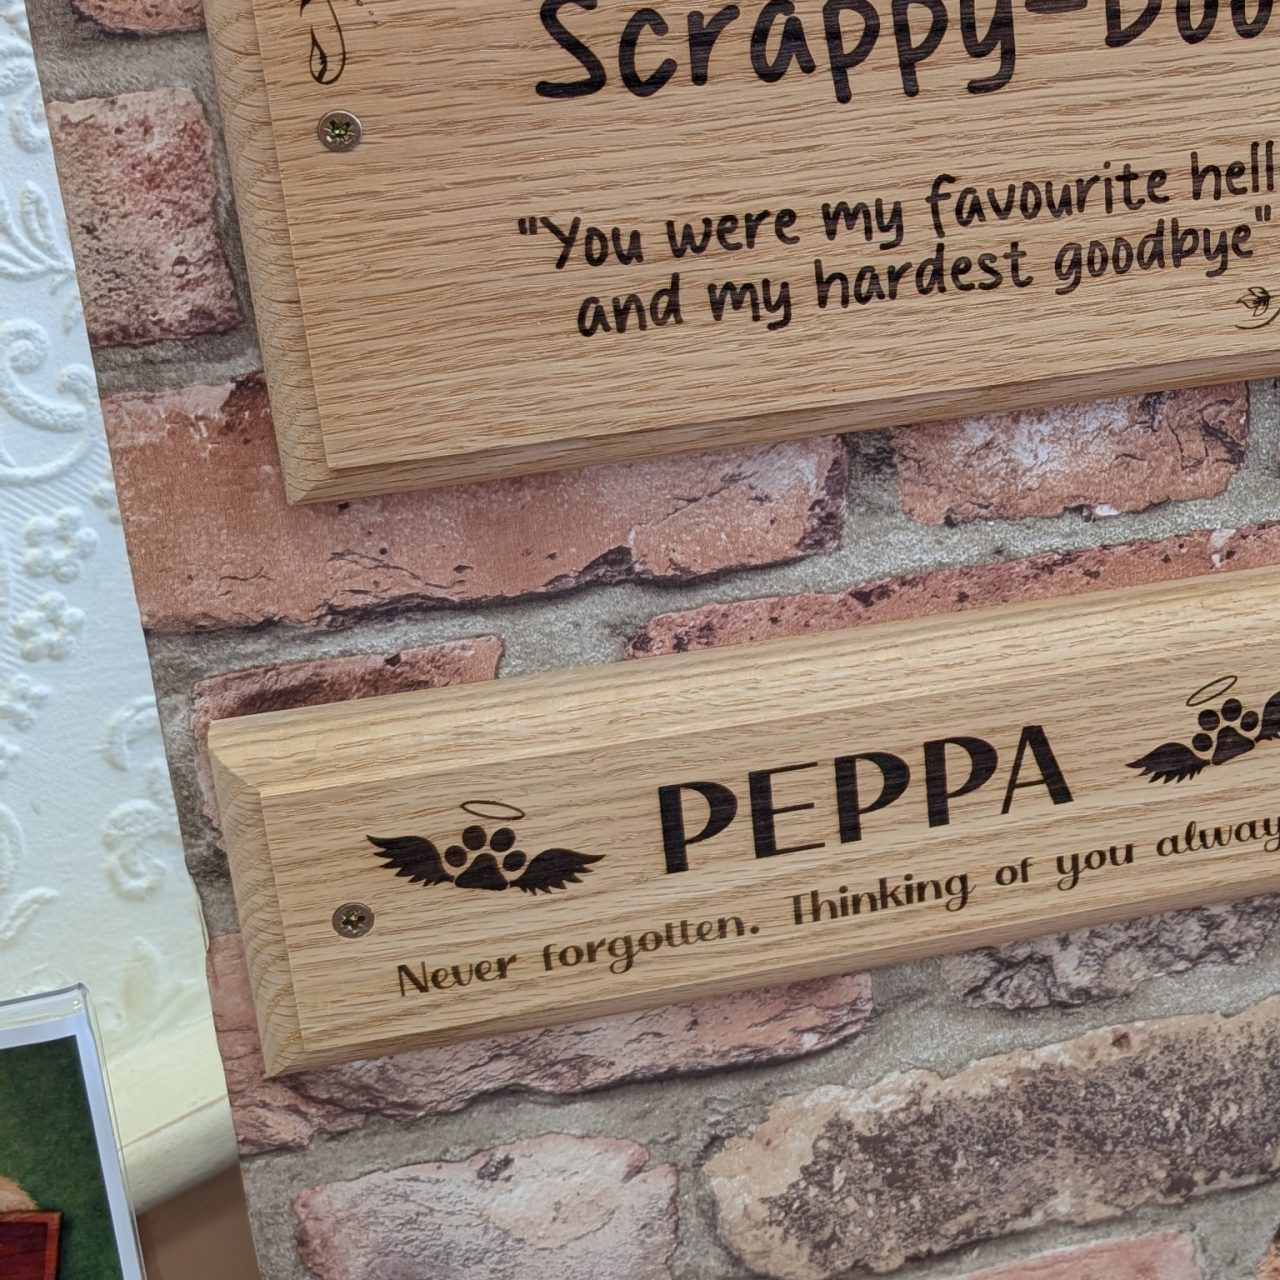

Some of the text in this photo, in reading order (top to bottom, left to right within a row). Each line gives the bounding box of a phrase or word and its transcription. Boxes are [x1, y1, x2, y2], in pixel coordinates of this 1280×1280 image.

[518, 213, 643, 270] "You
[667, 204, 800, 258] were
[822, 190, 905, 250] my
[927, 159, 1170, 237] favourite
[577, 205, 1273, 337] and my hardest goodbye"
[657, 724, 1075, 875] PEPPA
[397, 952, 518, 997] Never
[541, 914, 760, 975] forgotten.
[792, 871, 975, 930] Thinking
[994, 853, 1037, 890] of
[1056, 843, 1136, 893] you
